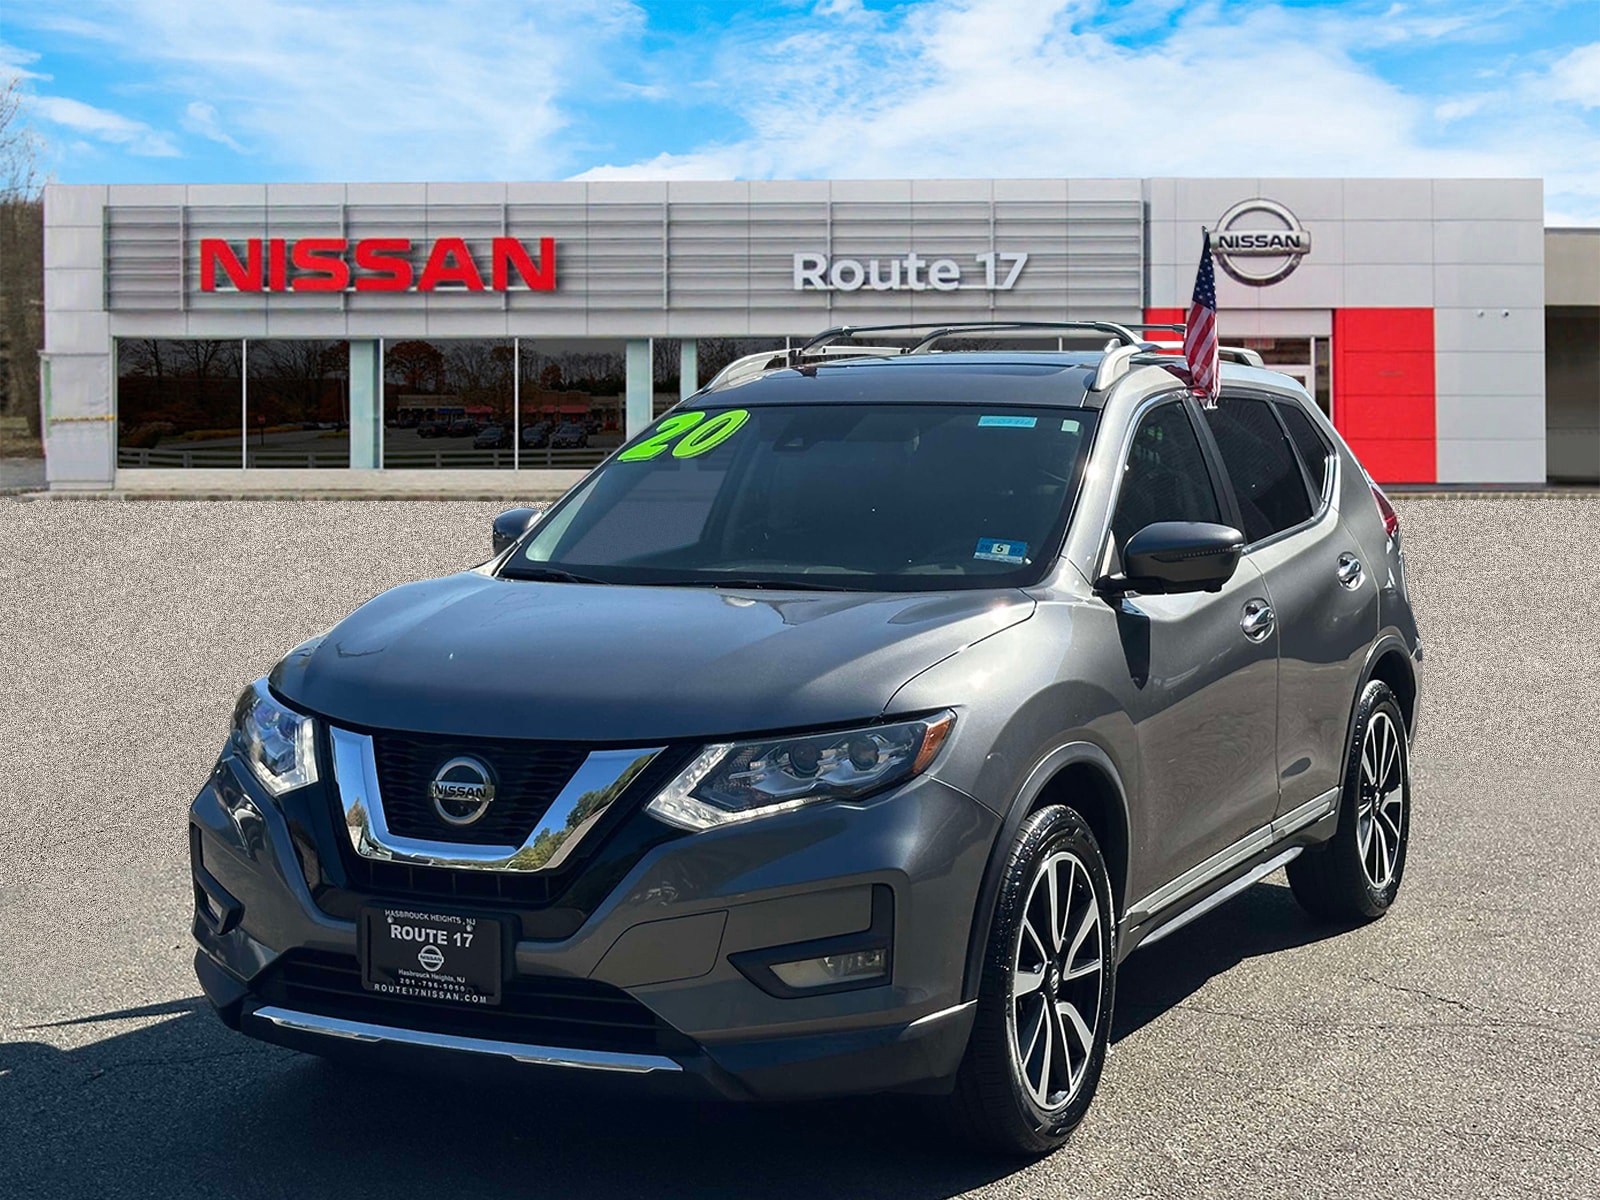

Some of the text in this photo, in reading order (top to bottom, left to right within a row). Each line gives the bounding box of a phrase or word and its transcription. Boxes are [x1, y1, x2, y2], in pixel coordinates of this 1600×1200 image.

[1219, 235, 1300, 248] NISSAN
[200, 237, 556, 292] NISSAN
[793, 252, 1028, 291] Route 17
[617, 409, 751, 462] 20
[996, 544, 1003, 552] 5
[434, 783, 487, 798] NISSAN
[385, 909, 430, 921] HASBROUCK
[466, 918, 476, 926] NJ
[390, 924, 474, 948] ROUTE 17
[420, 954, 442, 962] NISSAN
[398, 969, 430, 979] Hasbrouck
[374, 983, 487, 1004] ROUTE17NISSAN.COM
